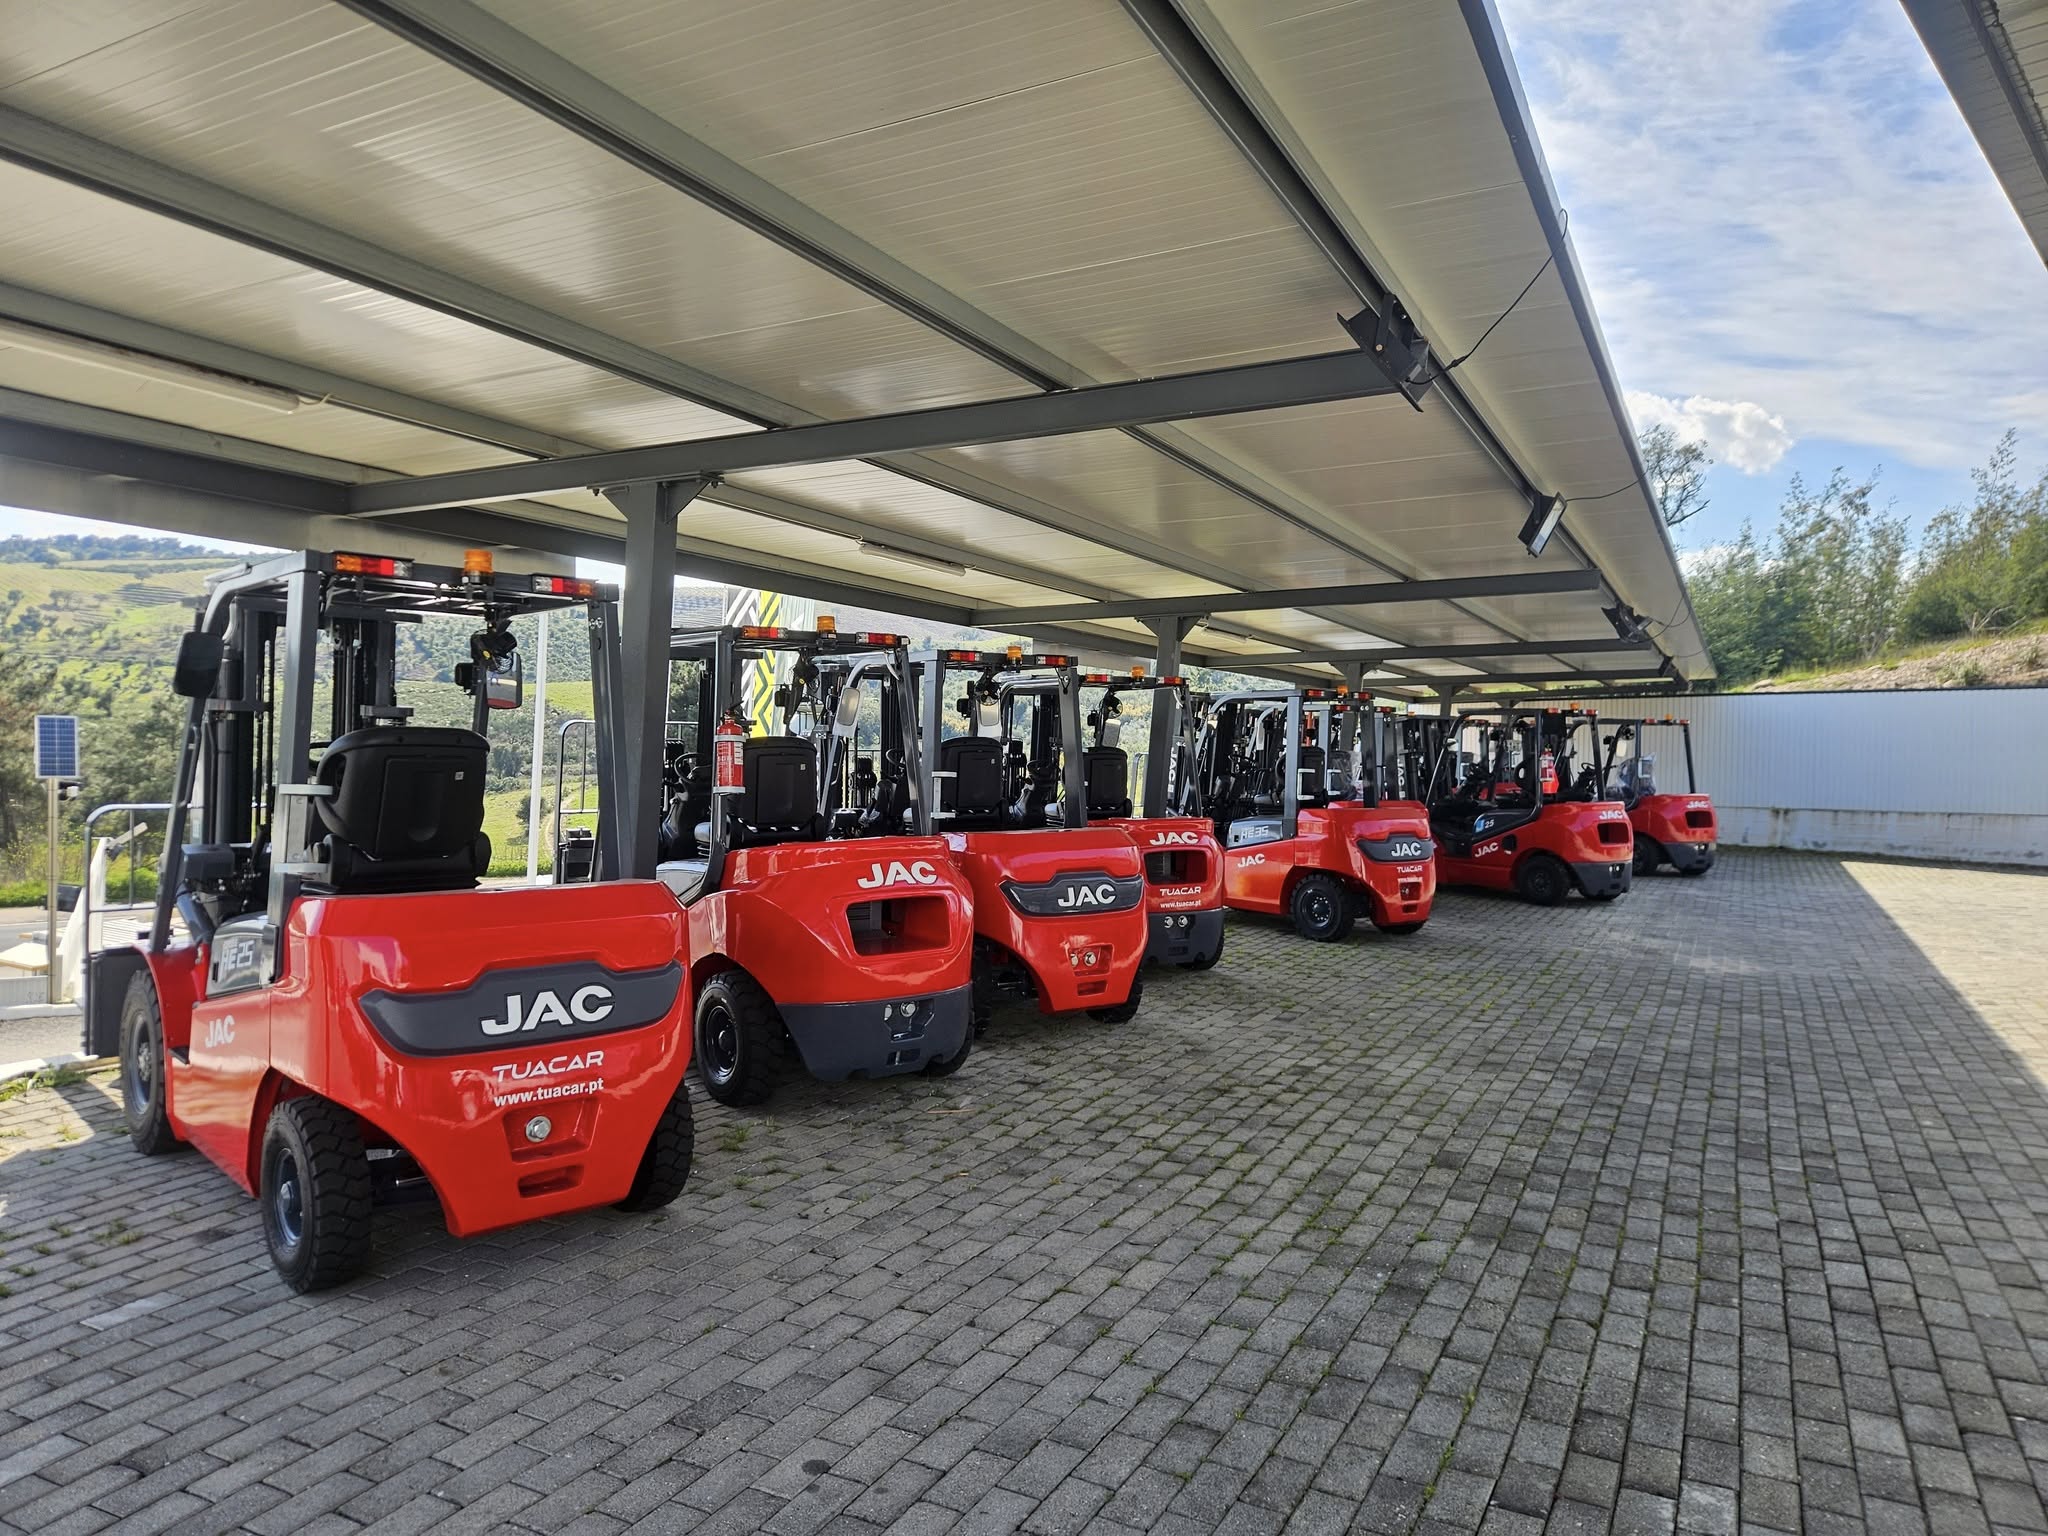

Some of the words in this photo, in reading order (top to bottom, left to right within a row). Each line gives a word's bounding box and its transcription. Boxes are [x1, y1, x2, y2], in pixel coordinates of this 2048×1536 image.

[1686, 801, 1709, 809] JAC
[1599, 810, 1623, 820] JAC
[1149, 831, 1200, 846] JAC
[1390, 842, 1421, 857] JAC
[1475, 842, 1499, 858] JAC
[1237, 853, 1266, 868] JAC
[857, 860, 937, 889] JAC
[1396, 864, 1423, 873] TUACAR
[1057, 884, 1117, 907] JAC
[1159, 886, 1202, 897] TUACAR
[480, 985, 613, 1036] JAC
[204, 1014, 236, 1049] JAC
[492, 1050, 605, 1083] TUACAR
[493, 1077, 605, 1107] www.tuacar.pt
